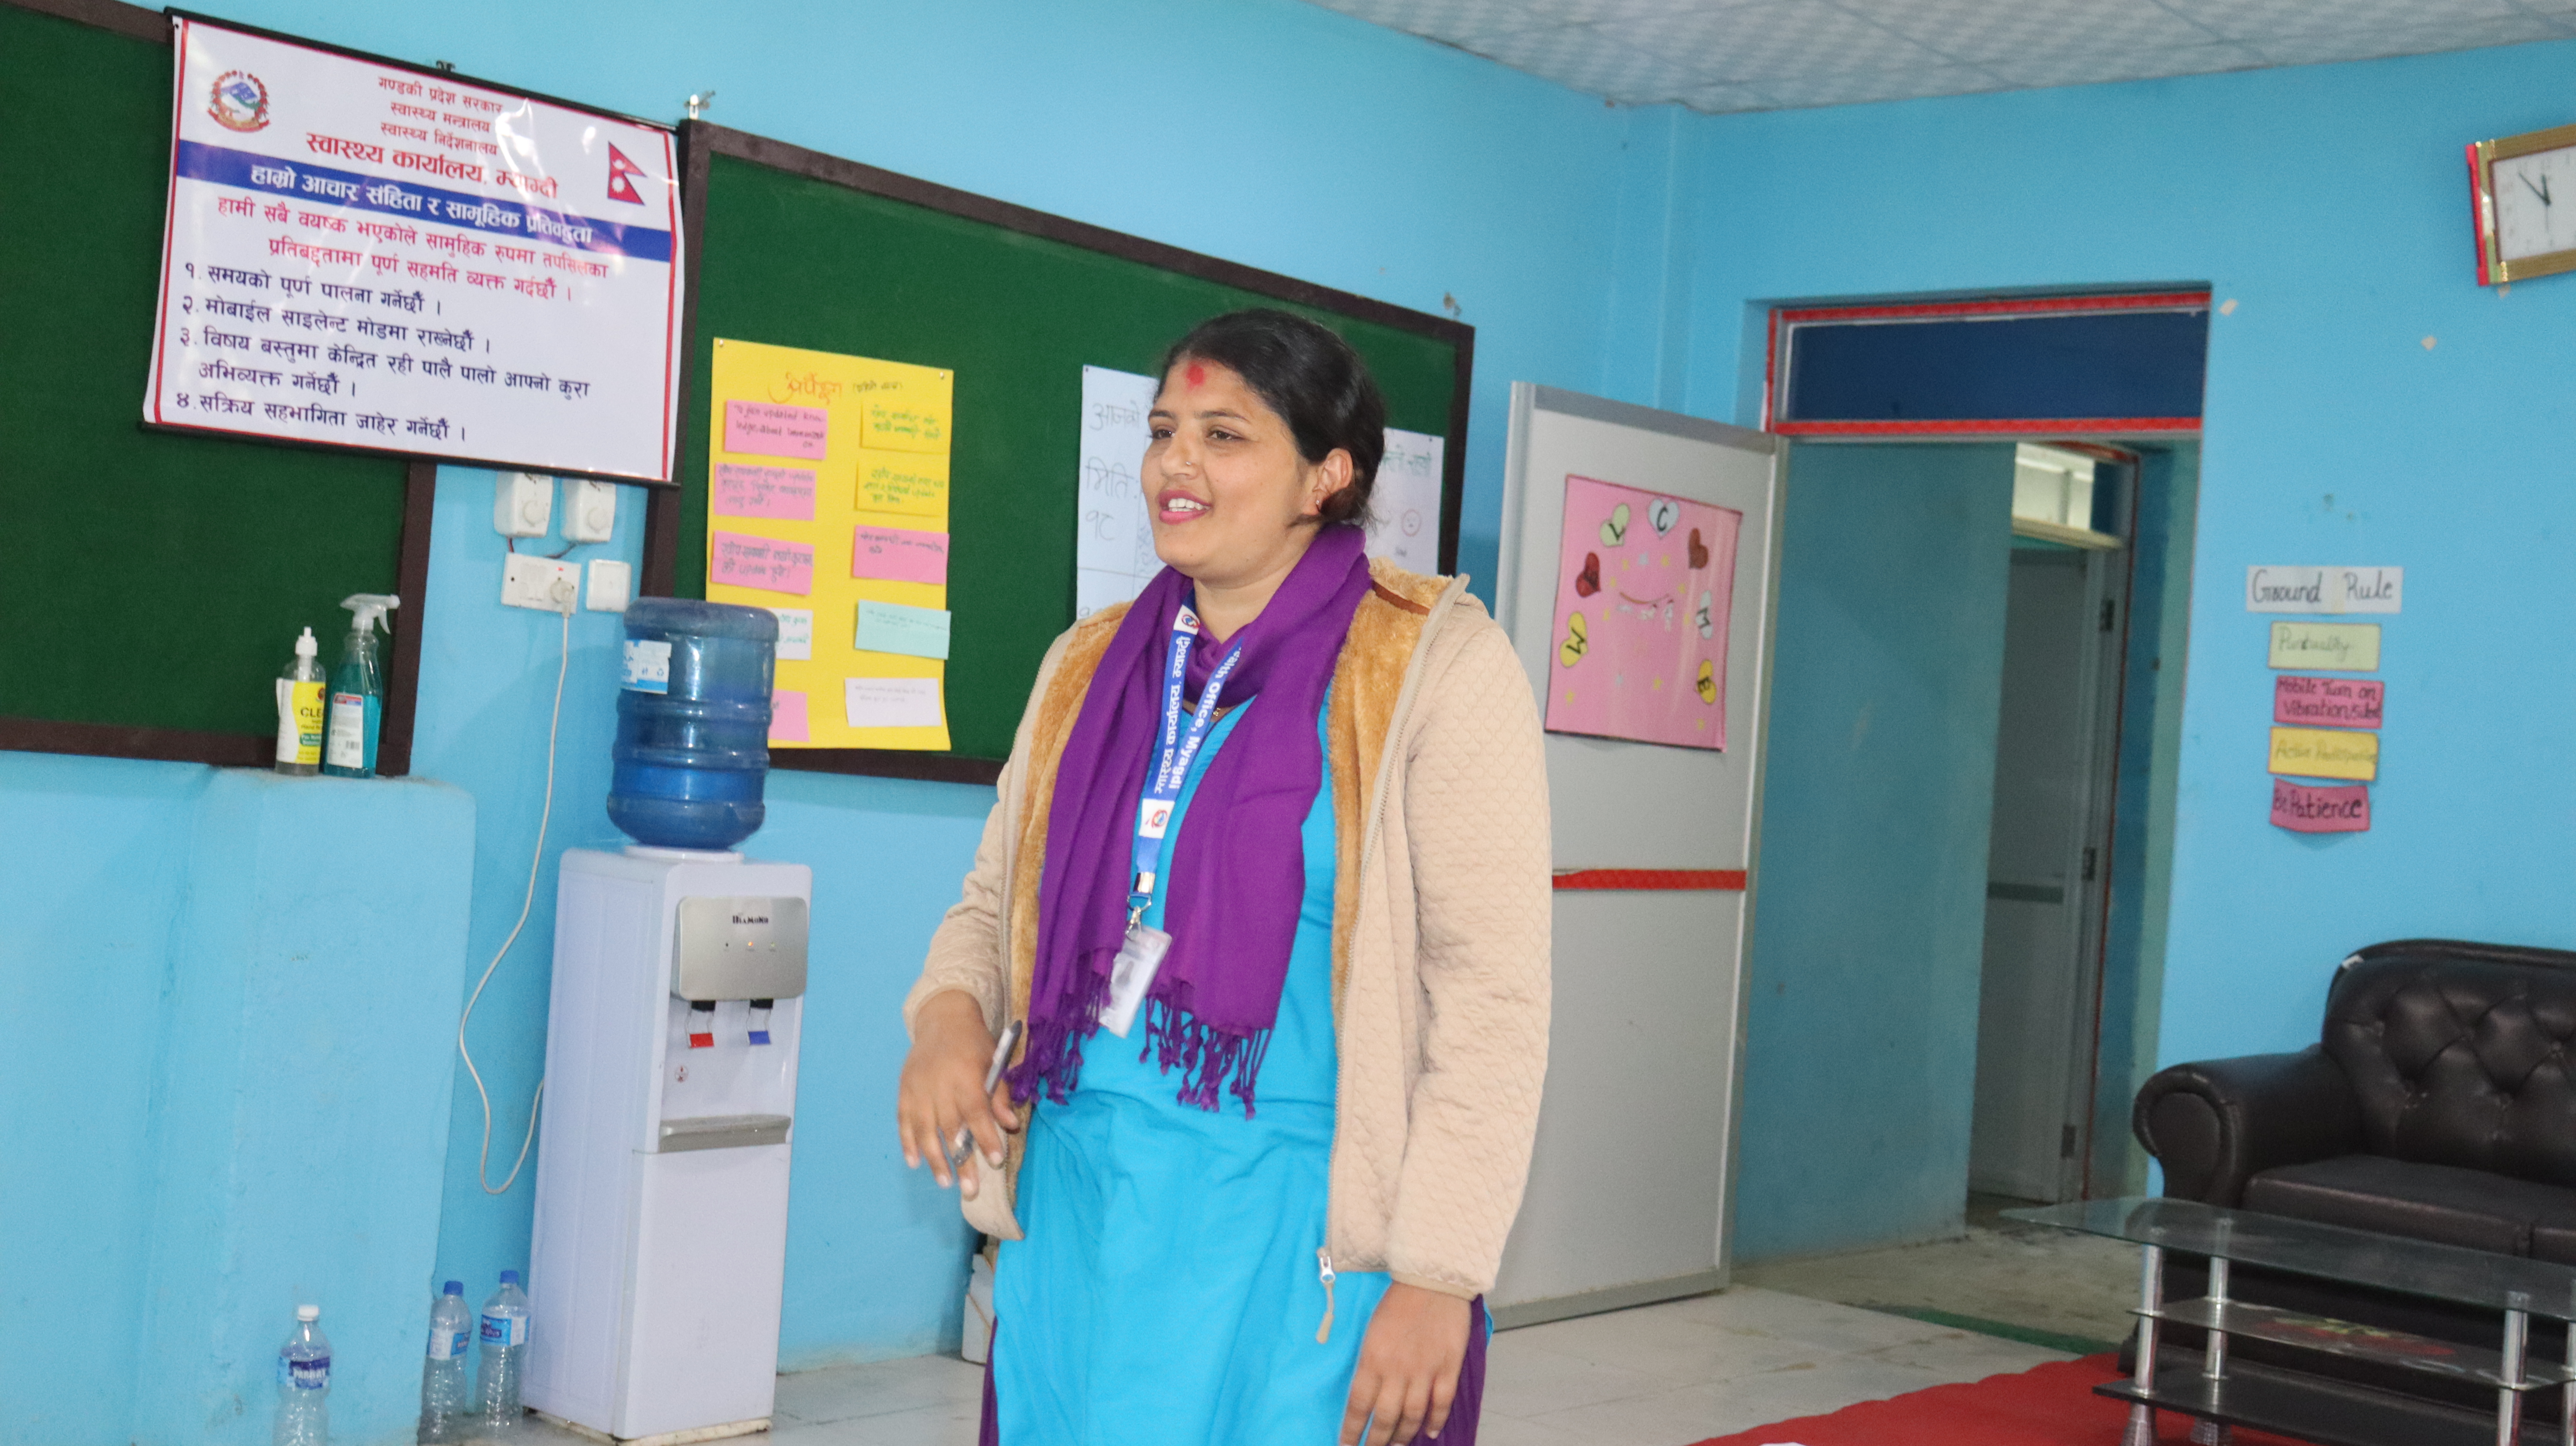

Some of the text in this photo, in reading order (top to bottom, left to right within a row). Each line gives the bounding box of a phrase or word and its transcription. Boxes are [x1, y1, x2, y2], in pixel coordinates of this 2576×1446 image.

[379, 76, 502, 113] गण्डकी प्रदेश सरकार
[381, 122, 428, 142] स्वास्थ्य
[391, 102, 491, 133] स्वास्थ्य मन्त्रालय
[307, 132, 385, 164] स्वास्थ्य
[251, 164, 297, 189] हाम्रो
[301, 174, 360, 201] आचार
[366, 184, 422, 211] संहिता
[427, 197, 441, 216] र
[445, 200, 521, 228] सामूहिक
[218, 196, 255, 218] हामी
[264, 201, 290, 224] सबै
[356, 220, 418, 246] भएकोले
[426, 231, 487, 258] सामुहिक
[208, 265, 272, 289] समयको
[280, 276, 313, 298] पूर्ण
[321, 283, 373, 304] पालना
[371, 253, 399, 276] पूर्ण
[407, 261, 459, 283] सहमति
[466, 270, 507, 291] व्यक्त
[205, 295, 272, 323] मोबाईल
[282, 309, 349, 332] साइलेन्ट
[357, 317, 408, 341] मोडमा
[199, 359, 283, 387] अभिव्यक्त
[204, 325, 252, 350] विषय
[260, 338, 319, 364] बस्तुमा
[327, 343, 378, 369] केन्द्रित
[386, 353, 414, 375] रही
[422, 358, 453, 378] पालै
[460, 366, 497, 384] पालो
[559, 379, 591, 400] कुरा
[199, 391, 255, 416] सक्रिय
[264, 402, 347, 426] सहभागिता
[355, 412, 398, 436] जाहेर
[2252, 569, 2393, 603] Ground Rule
[1173, 636, 1191, 678] म्याग्दी
[1169, 647, 1241, 789] ealth Office, Myagdi
